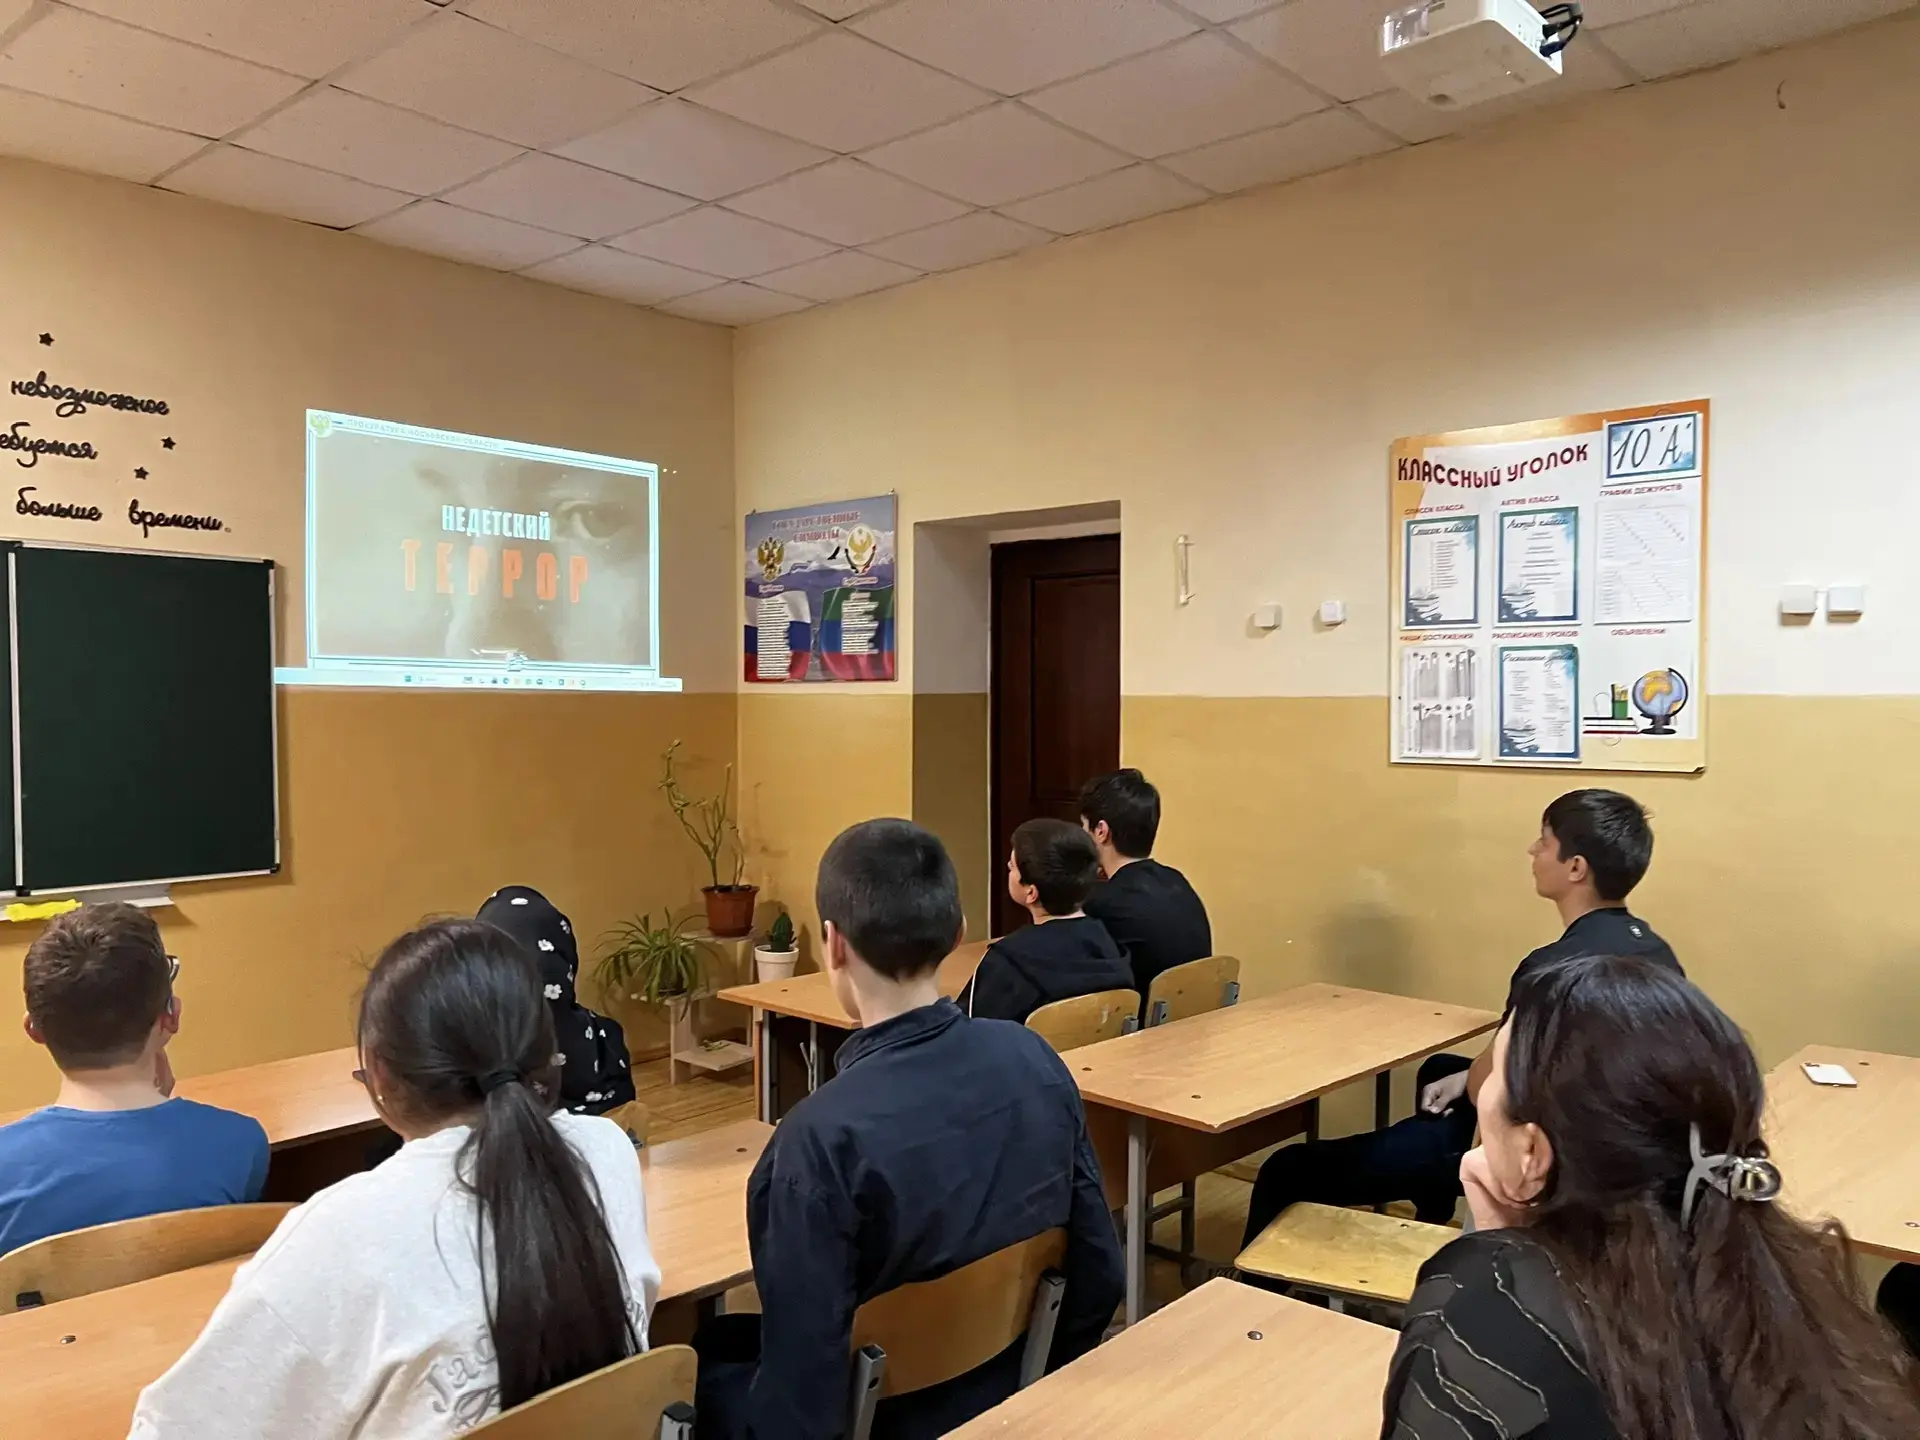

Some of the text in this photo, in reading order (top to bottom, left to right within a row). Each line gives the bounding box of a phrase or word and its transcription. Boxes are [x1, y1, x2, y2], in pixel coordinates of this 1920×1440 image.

[11, 371, 170, 417] невозможное
[1398, 443, 1589, 489] КЛАССНЫЙ УГОЛОК
[1613, 427, 1651, 470] 10
[16, 486, 103, 521] больше
[1403, 503, 1466, 516] СПИСОК КЛАССА
[1500, 494, 1561, 507] АКТИВ КЛАССА
[441, 504, 550, 541] НЕДЕТСКИЙ
[400, 538, 589, 604] ТЕРРОР
[1491, 630, 1579, 640] РАСПИСАНИЕ УРОКОВ
